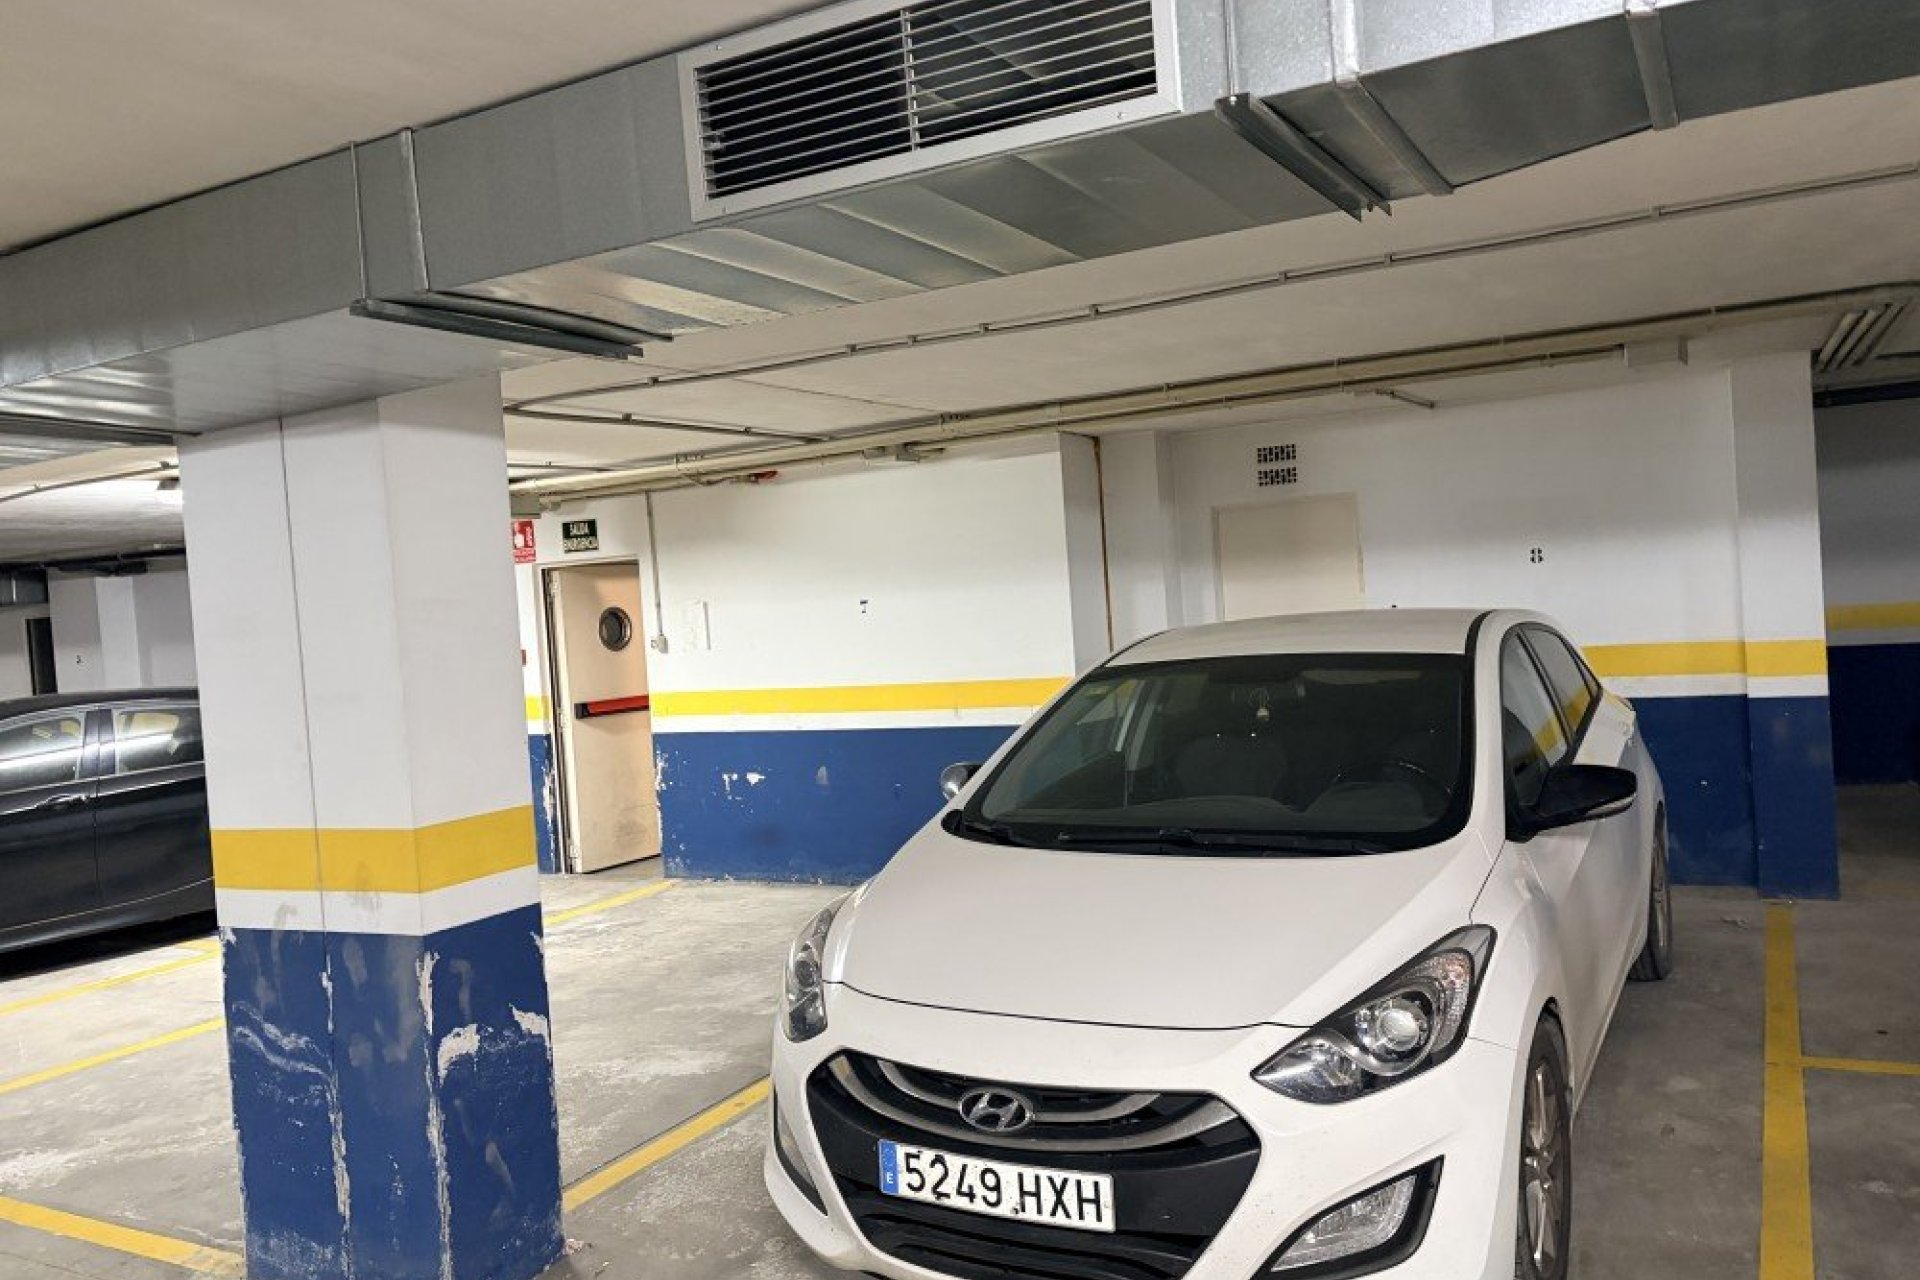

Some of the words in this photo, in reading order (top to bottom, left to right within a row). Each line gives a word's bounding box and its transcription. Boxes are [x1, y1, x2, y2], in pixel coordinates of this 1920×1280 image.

[1530, 547, 1543, 563] 8
[886, 1172, 894, 1185] E
[904, 1151, 1002, 1208] 5249
[1017, 1171, 1103, 1223] HXH
